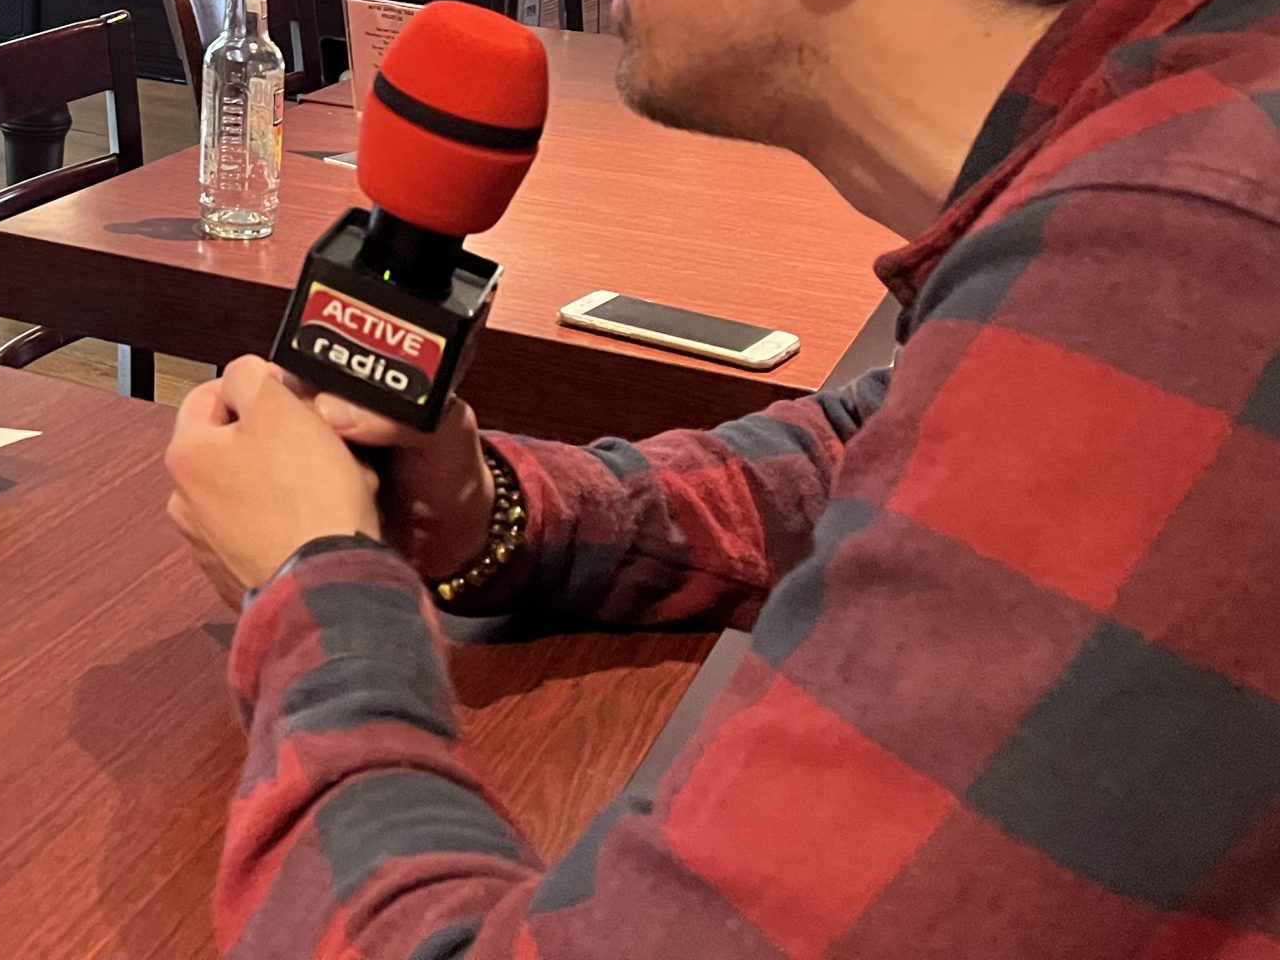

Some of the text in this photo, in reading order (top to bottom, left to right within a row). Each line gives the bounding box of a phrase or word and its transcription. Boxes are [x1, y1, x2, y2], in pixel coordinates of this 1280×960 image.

[219, 96, 244, 191] DESPERADOS
[322, 299, 424, 357] ACTIVE
[313, 337, 409, 391] radio
